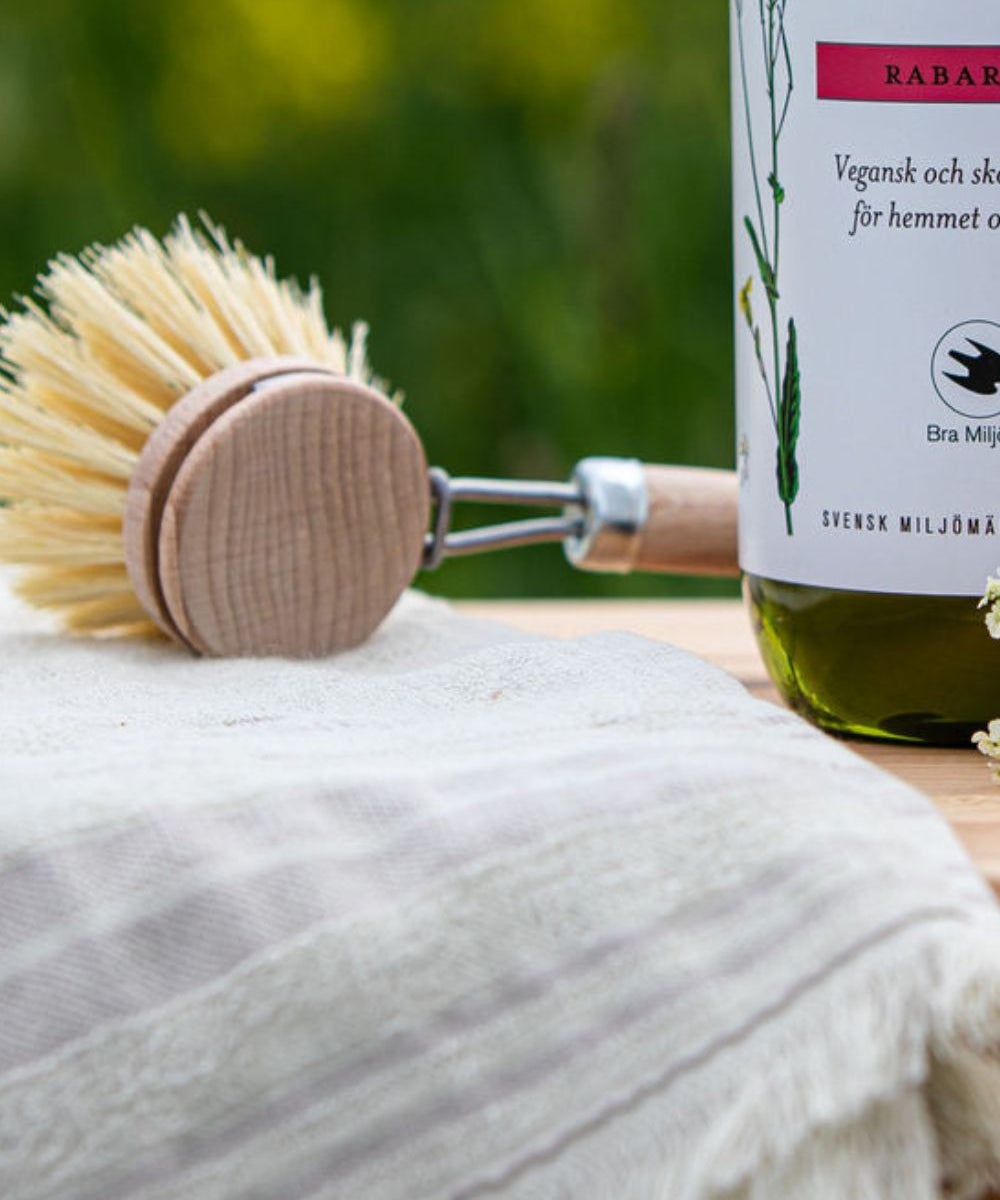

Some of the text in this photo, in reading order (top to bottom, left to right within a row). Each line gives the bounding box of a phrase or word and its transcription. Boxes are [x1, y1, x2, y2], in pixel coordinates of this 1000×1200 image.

[834, 153, 918, 193] Vegansk
[923, 156, 965, 185] och
[847, 198, 884, 237] för
[888, 200, 981, 231] hemmet
[926, 423, 960, 444] Bra
[822, 509, 888, 533] SVENSK
